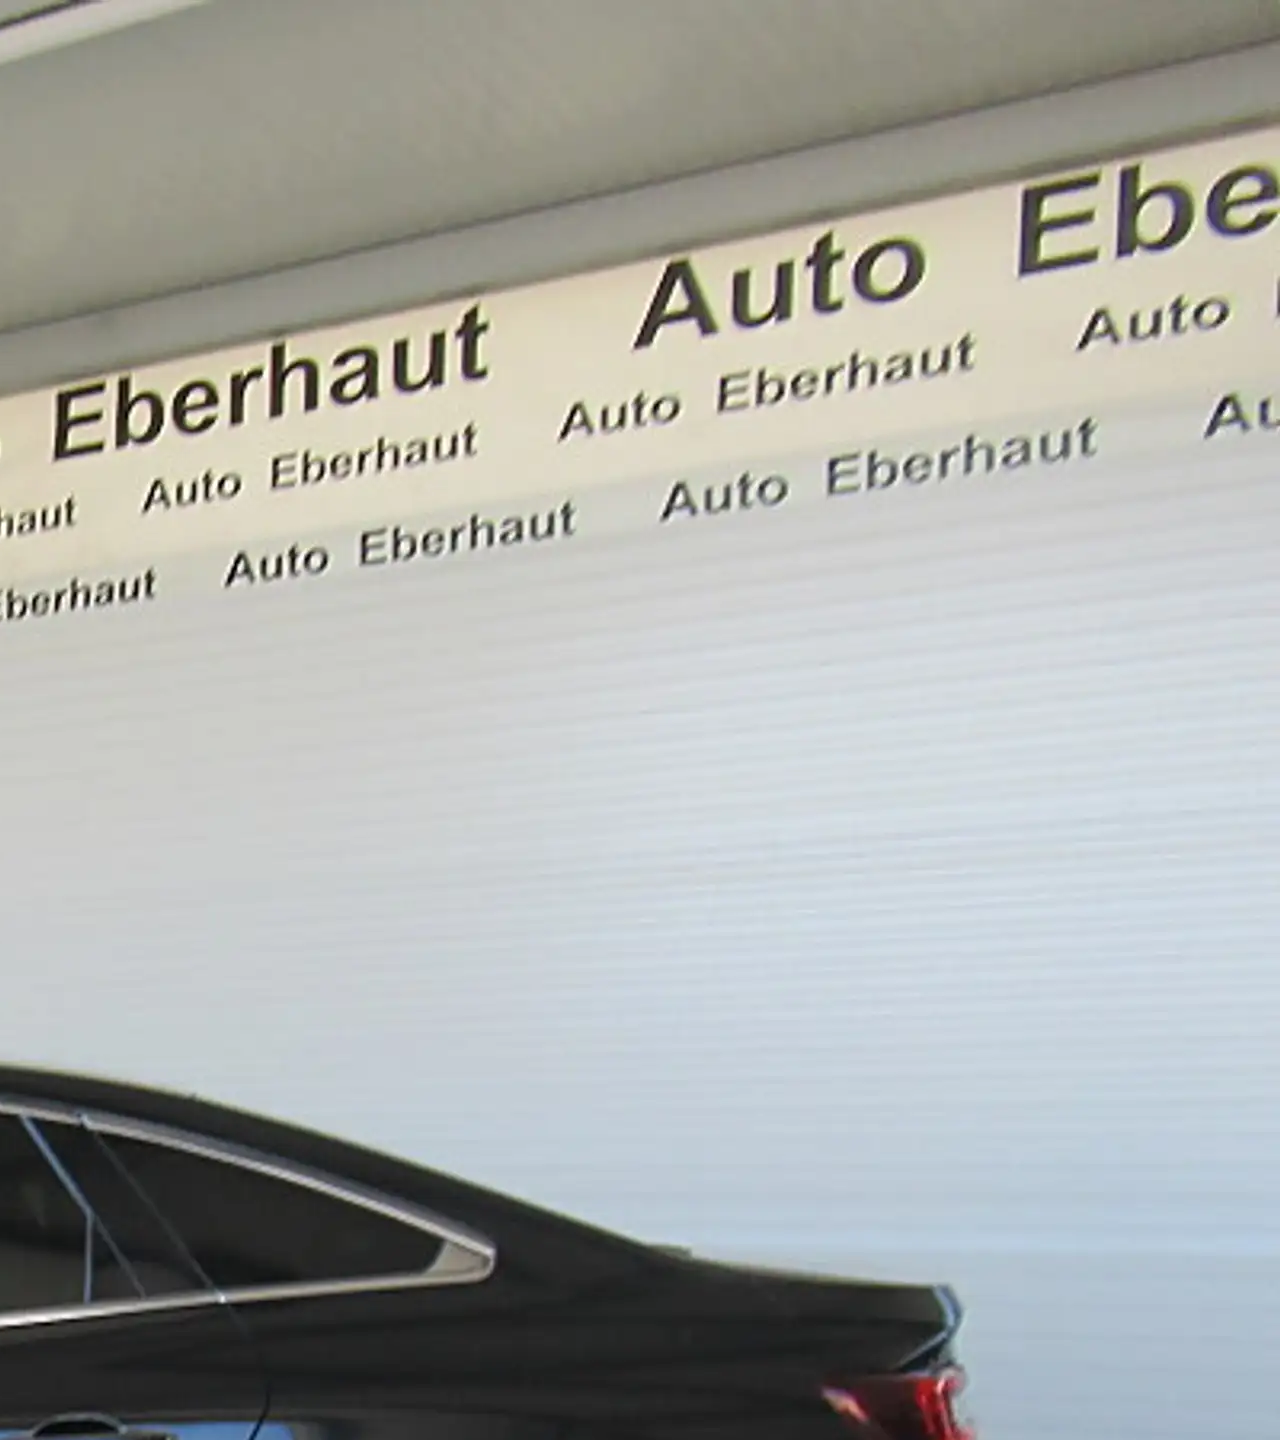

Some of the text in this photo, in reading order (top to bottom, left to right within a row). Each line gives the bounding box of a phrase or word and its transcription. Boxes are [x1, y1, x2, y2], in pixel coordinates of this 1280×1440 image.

[631, 163, 1280, 351] Auto Ebe
[1077, 296, 1229, 351] Auto
[51, 302, 489, 463] Eberhaut
[559, 334, 973, 440] Auto Eberhaut
[143, 424, 475, 512] Auto Eberhaut
[661, 417, 1095, 521] Auto Eberhaut
[225, 502, 573, 587] Auto Eberhaut
